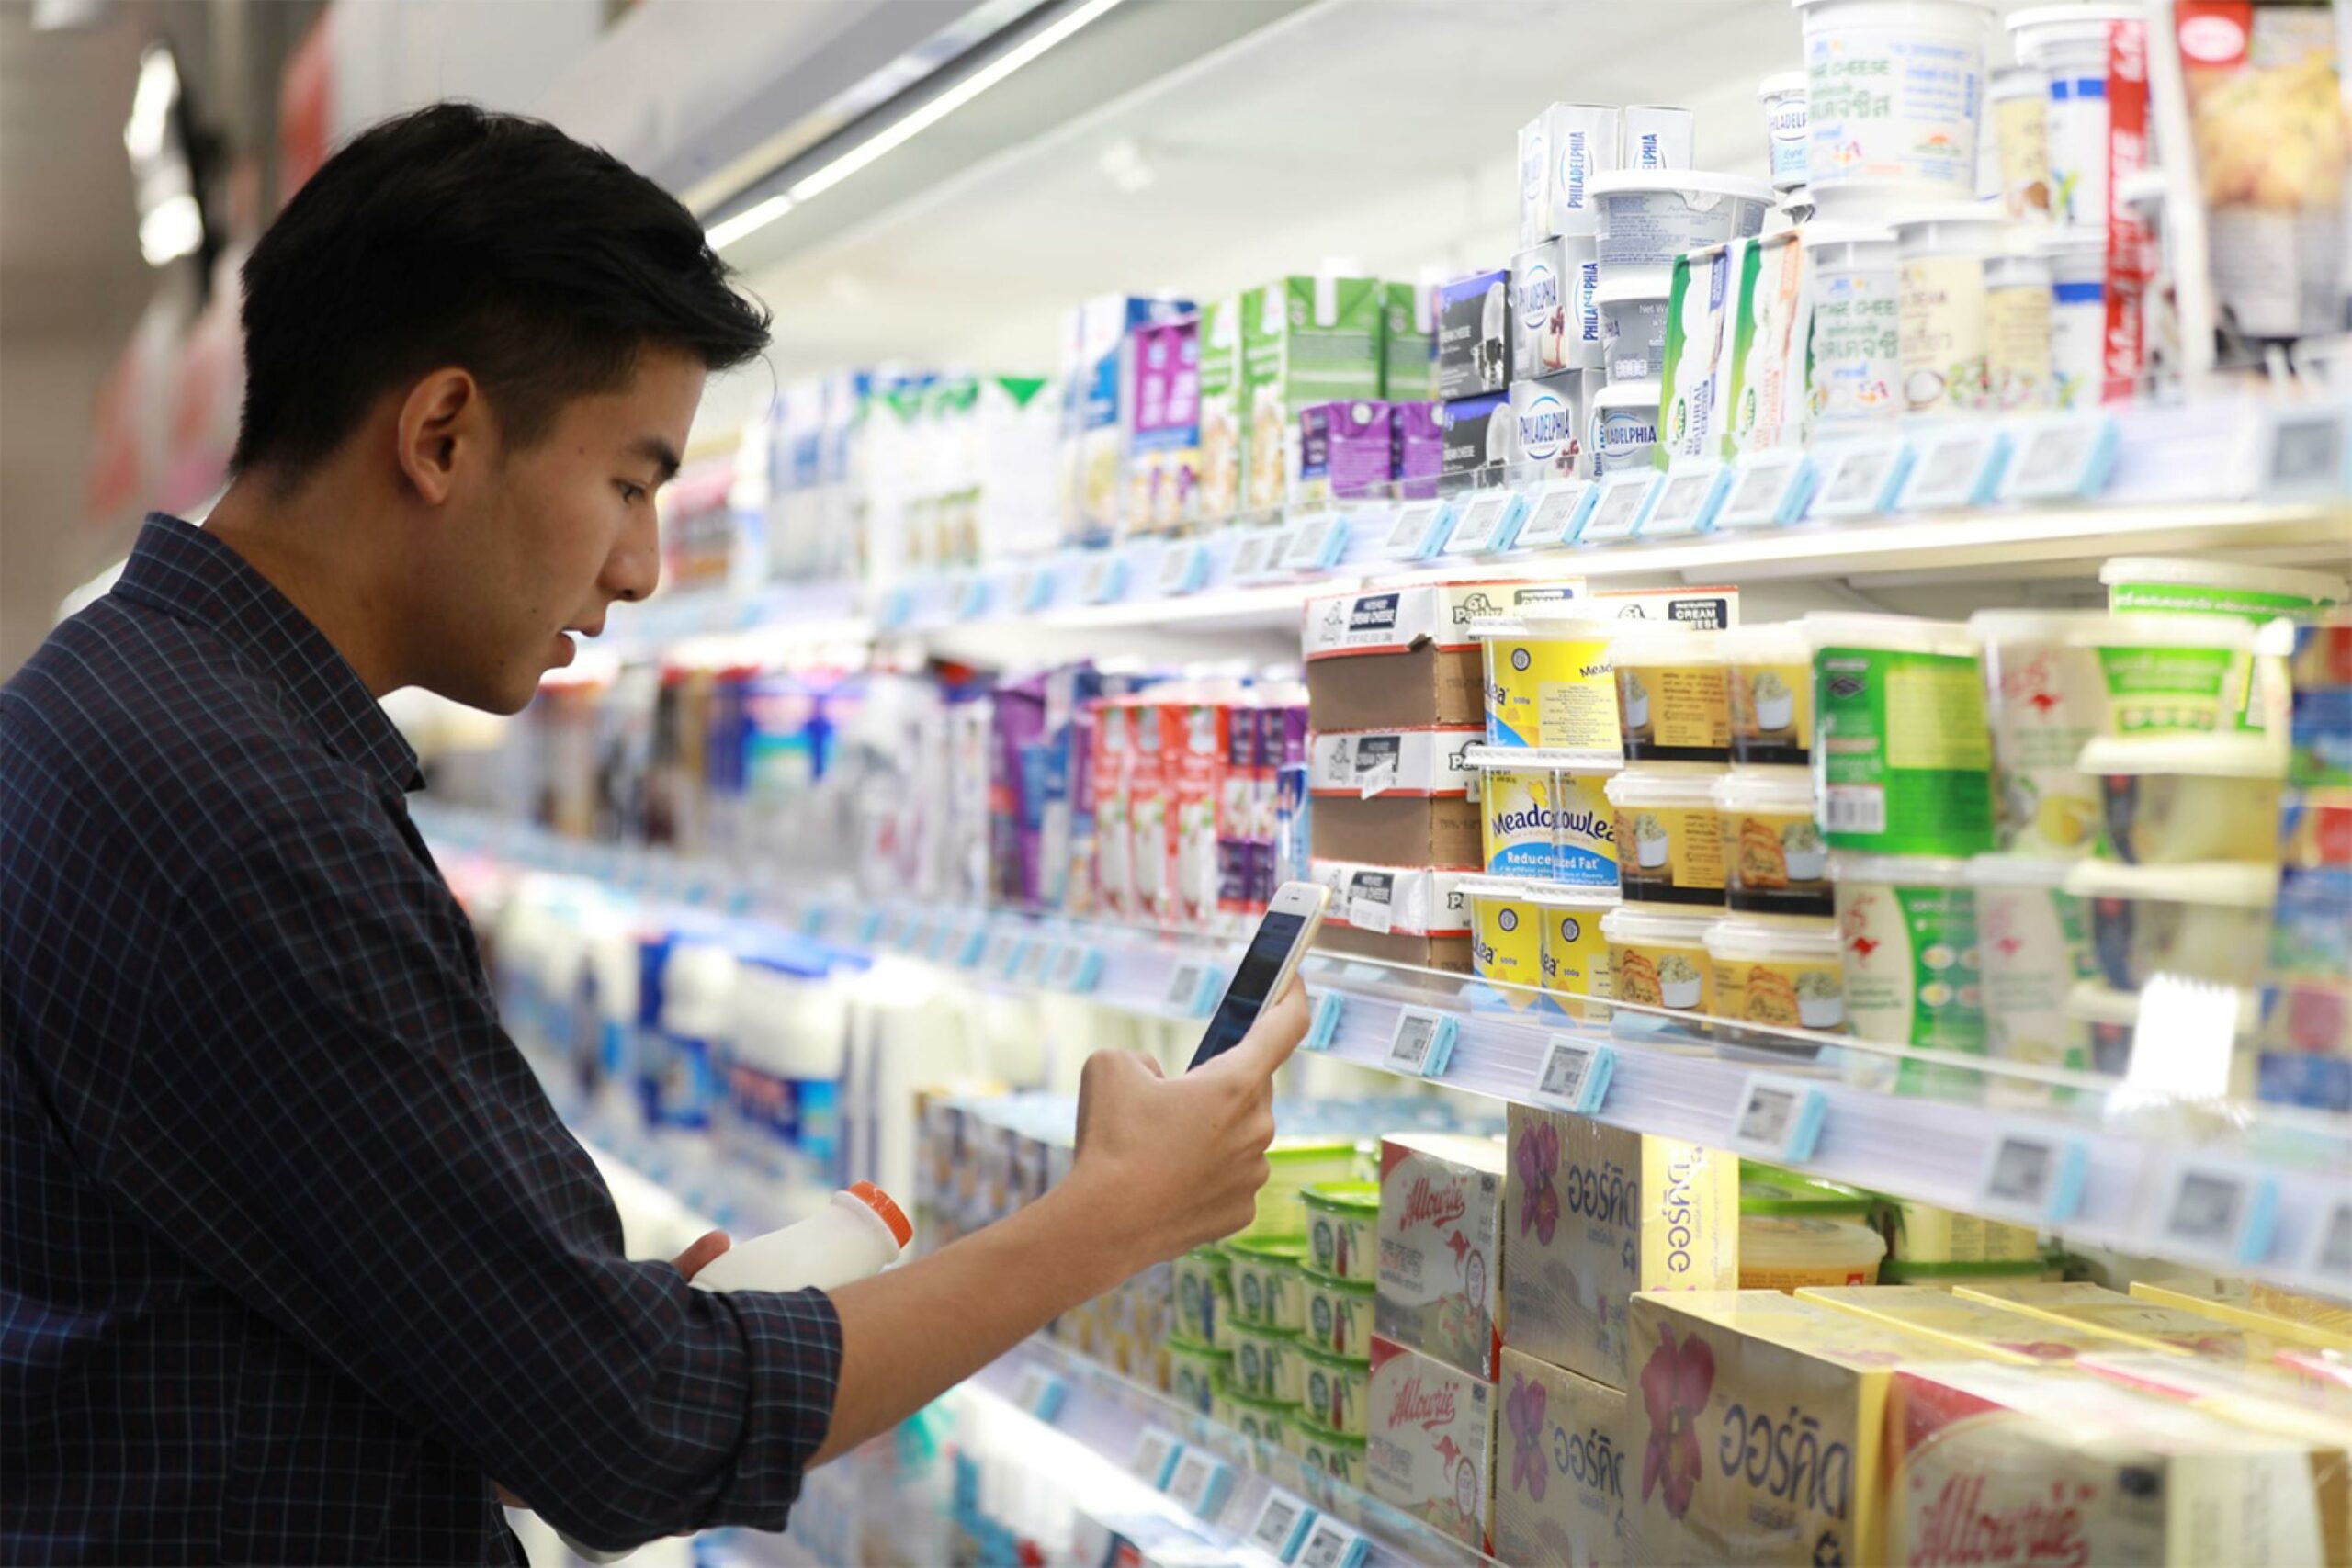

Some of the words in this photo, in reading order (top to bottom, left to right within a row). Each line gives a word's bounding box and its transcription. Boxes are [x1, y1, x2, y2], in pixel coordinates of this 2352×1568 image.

[1567, 130, 1585, 209] PHILADELPHIA
[1676, 609, 1716, 620] CREAM
[1579, 857, 1598, 870] Fat
[1568, 1160, 1638, 1231] ออร์คิด
[1720, 1404, 1849, 1522] ออร์คิด
